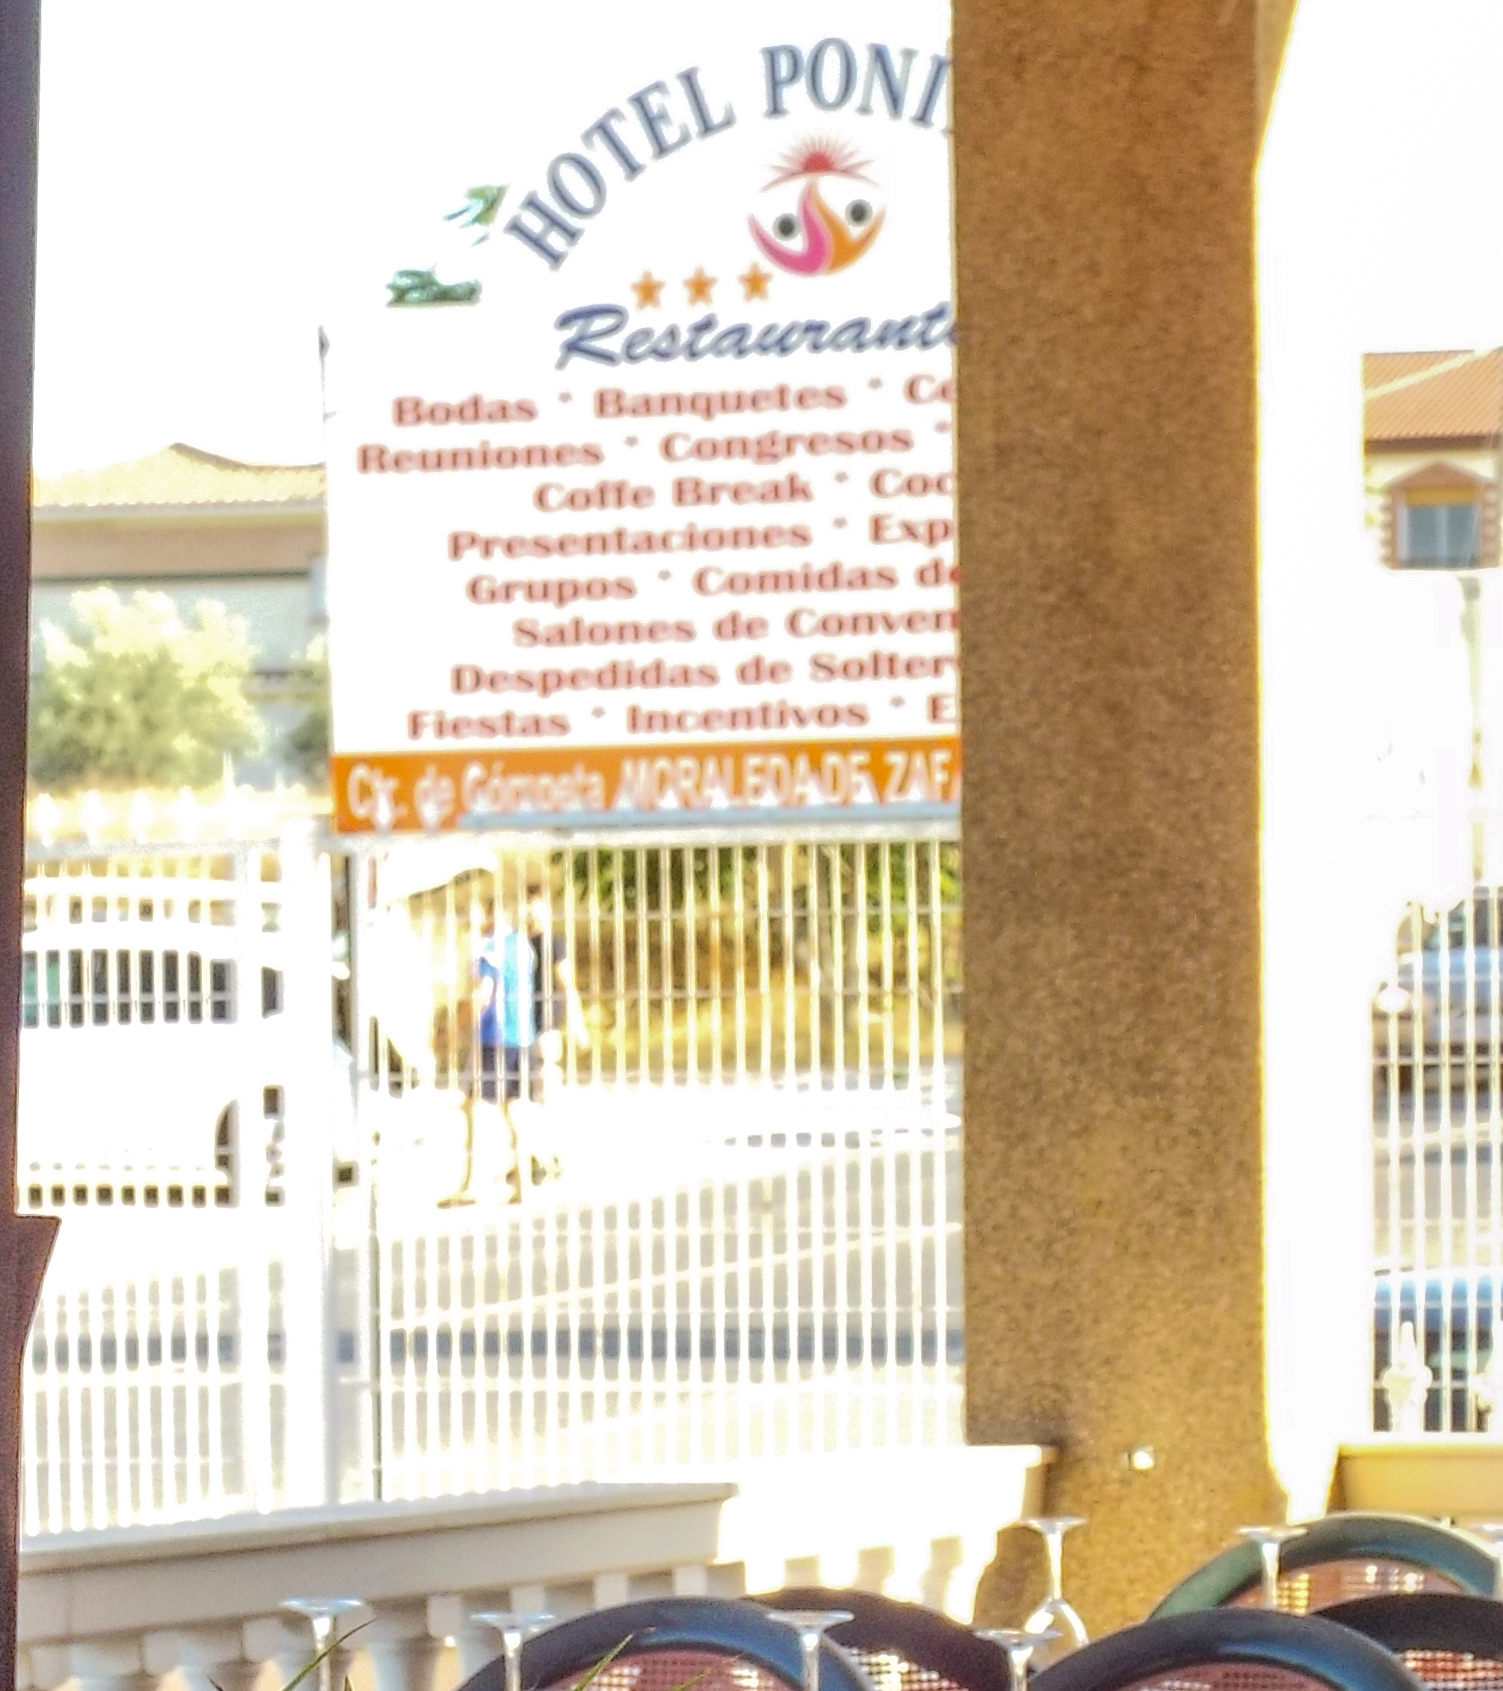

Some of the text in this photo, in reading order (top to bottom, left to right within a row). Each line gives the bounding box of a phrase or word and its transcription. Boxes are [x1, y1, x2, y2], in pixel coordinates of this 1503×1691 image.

[503, 36, 953, 271] HOTEL PONI
[392, 393, 538, 428] Bodas
[593, 383, 848, 422] Banquetes
[357, 430, 915, 475] Reuniones Congresos
[532, 468, 953, 513] Coffe Break Coc
[448, 514, 953, 562] Presentaciones Exp
[465, 574, 638, 609] Grupos
[692, 562, 899, 597] Comidas
[512, 616, 697, 648] Salones
[712, 610, 769, 641] de
[450, 648, 955, 699] Despedidas de Solter
[406, 709, 572, 741] Fiestas
[626, 699, 874, 738] Incentivos
[414, 766, 456, 822] de
[883, 748, 958, 803] ZAF
